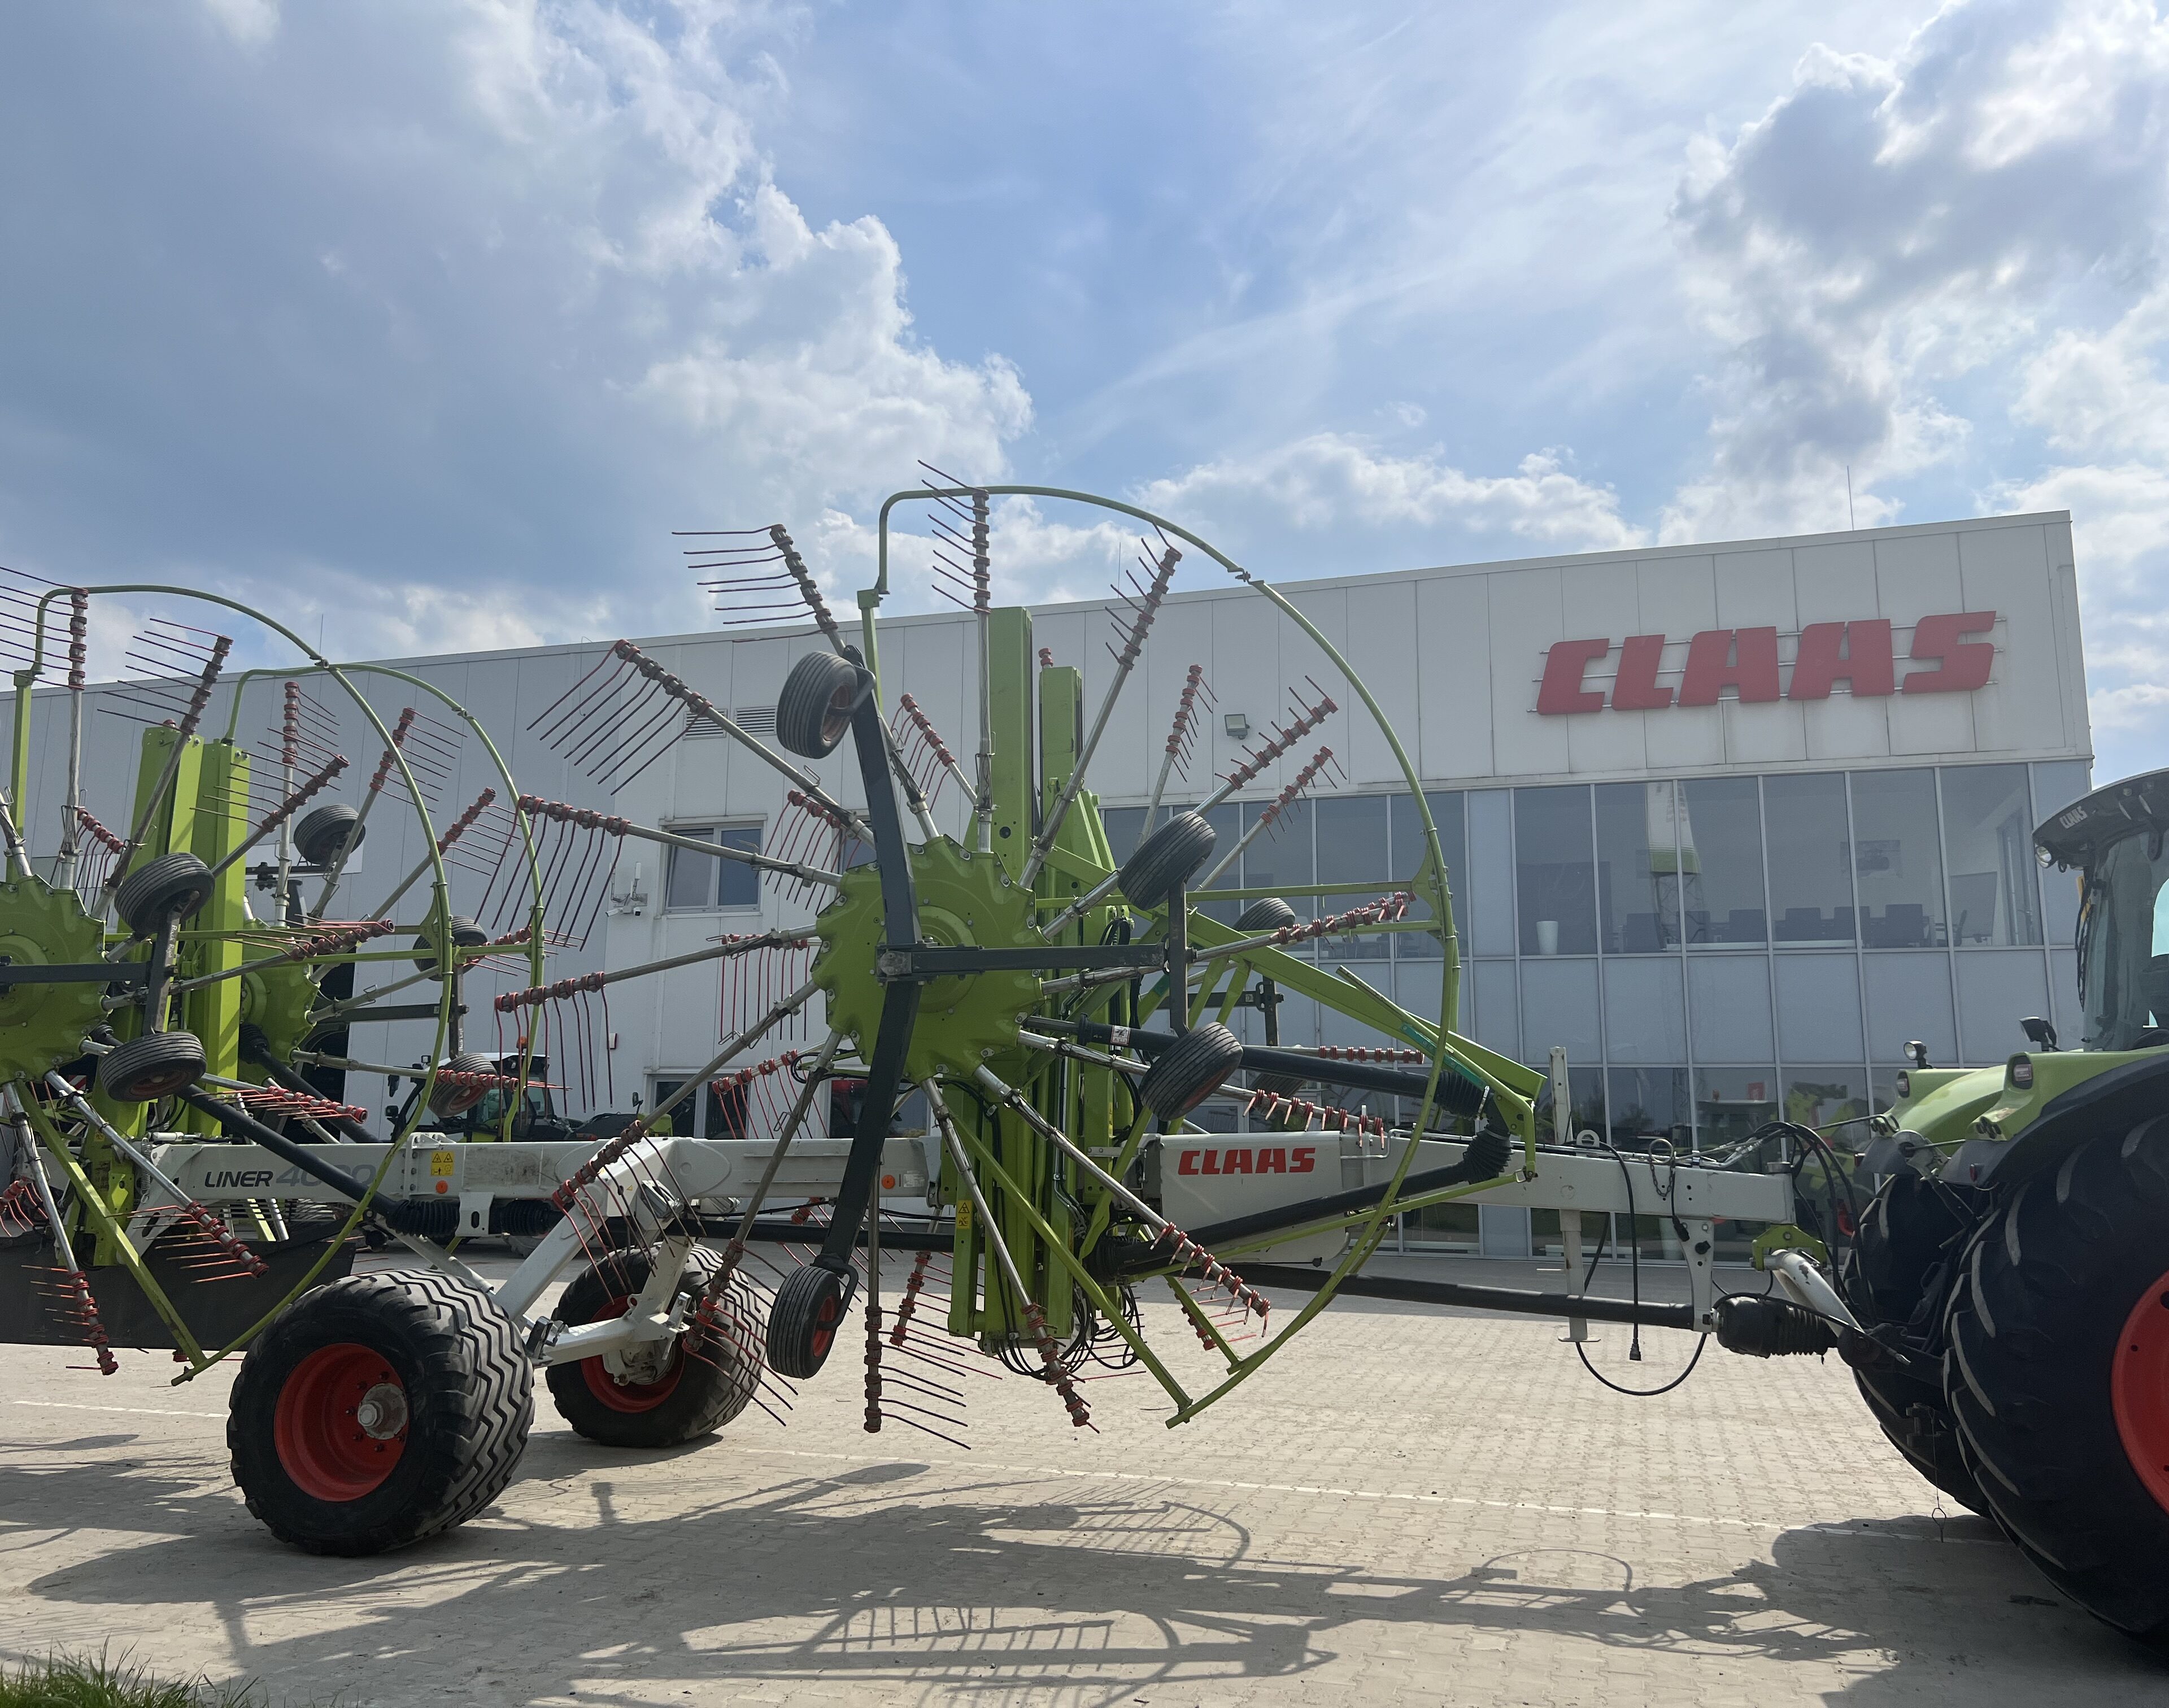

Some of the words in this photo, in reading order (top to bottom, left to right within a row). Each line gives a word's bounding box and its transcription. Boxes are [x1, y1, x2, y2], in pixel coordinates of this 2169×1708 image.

[1536, 611, 1997, 715] CLAAS
[2059, 806, 2087, 829] CLAAS
[1178, 1148, 1316, 1175] CLAAS
[204, 1171, 273, 1187] LINER
